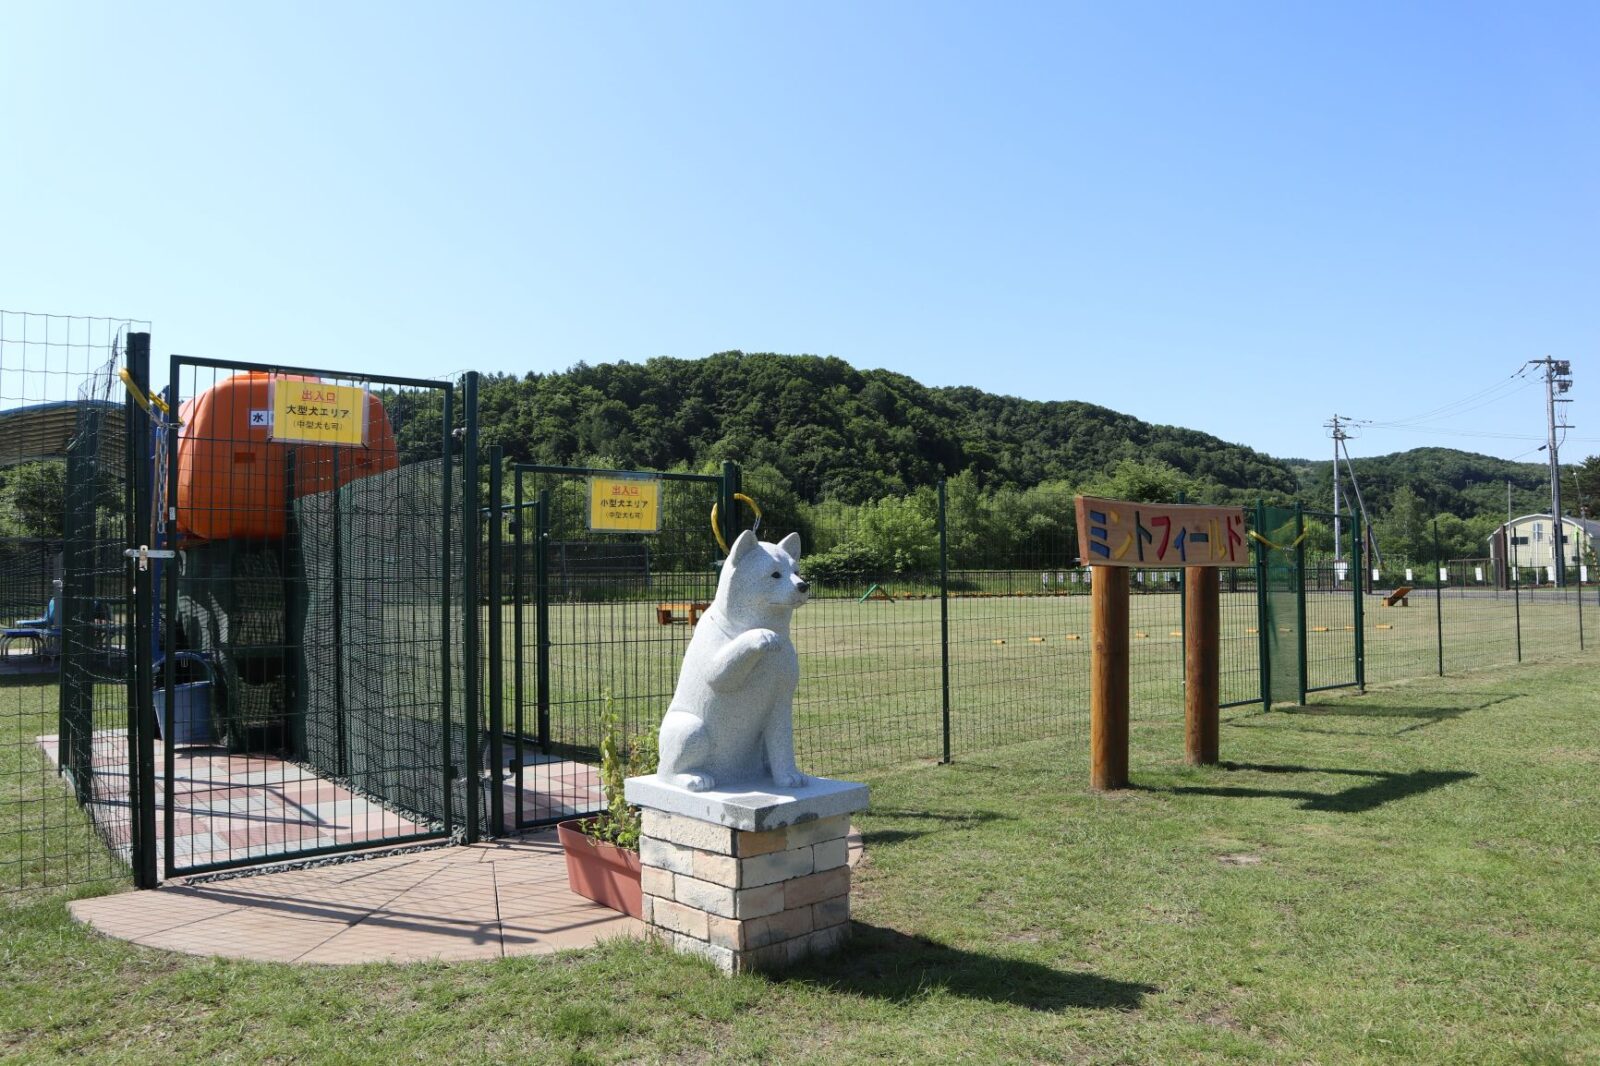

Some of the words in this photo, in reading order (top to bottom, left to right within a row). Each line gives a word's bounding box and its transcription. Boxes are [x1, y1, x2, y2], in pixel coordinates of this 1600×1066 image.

[301, 390, 336, 403] 出入口
[286, 405, 350, 418] 大型犬エリア
[611, 486, 639, 495] 出入口
[600, 499, 648, 508] 小型犬エリア
[1089, 509, 1242, 562] ミントフィールド
